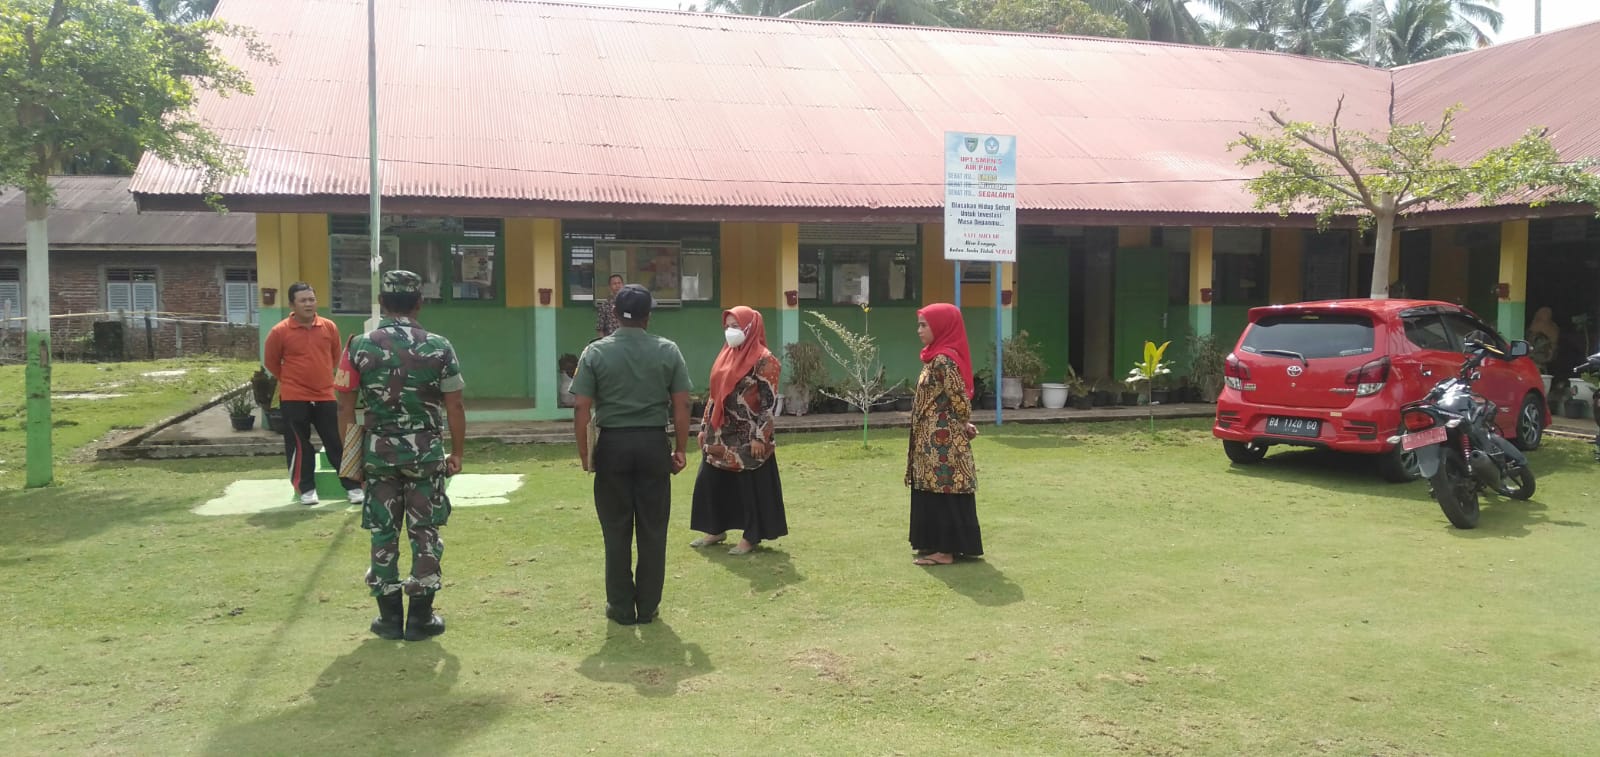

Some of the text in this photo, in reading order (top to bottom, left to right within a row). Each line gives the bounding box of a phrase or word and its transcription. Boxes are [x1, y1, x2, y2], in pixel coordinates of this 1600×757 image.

[977, 191, 1015, 199] SEGALANYA
[951, 201, 977, 209] Biasakan
[995, 203, 1011, 211] Sehat
[1268, 417, 1280, 427] BA
